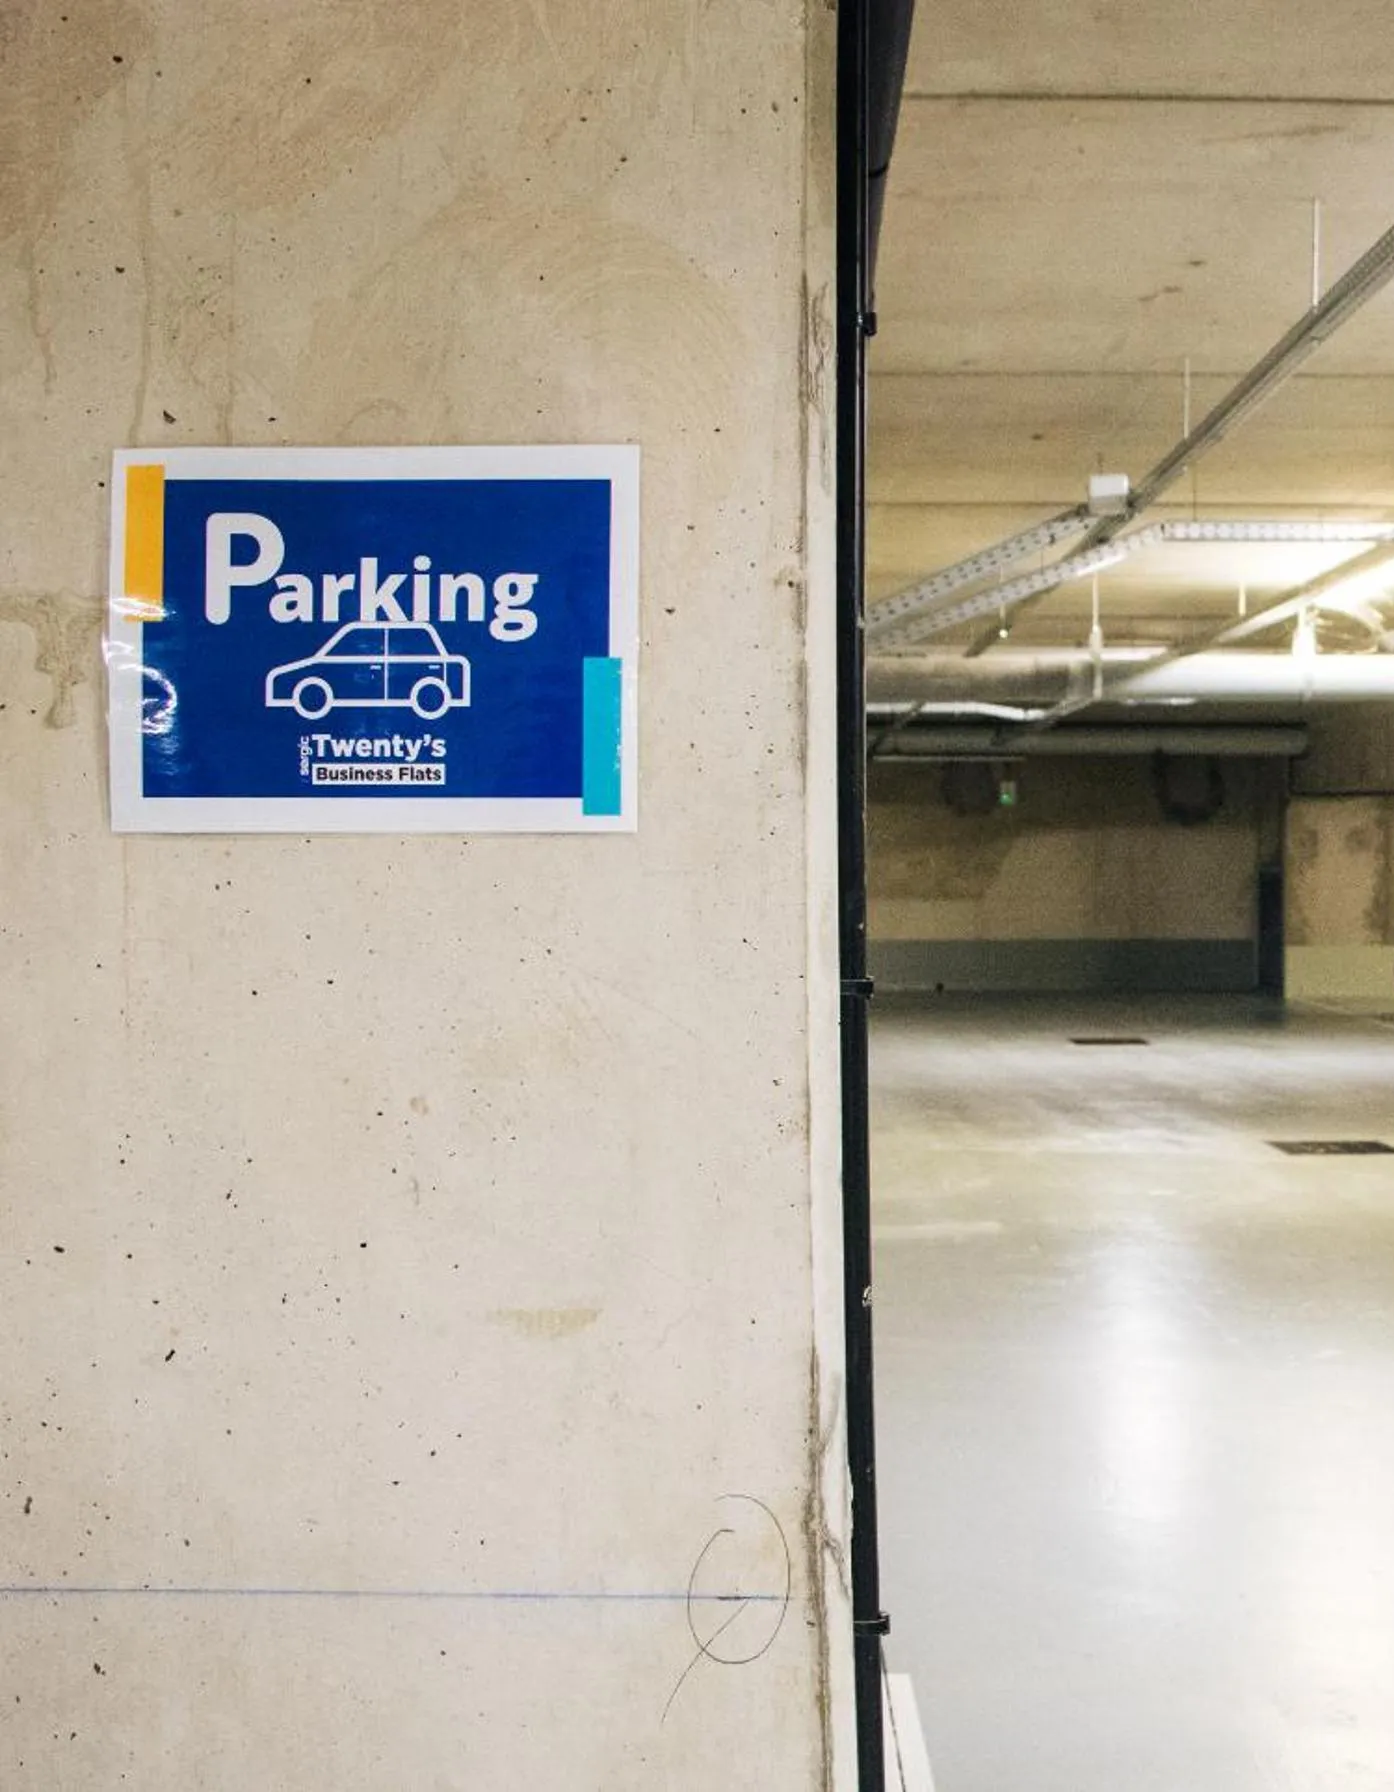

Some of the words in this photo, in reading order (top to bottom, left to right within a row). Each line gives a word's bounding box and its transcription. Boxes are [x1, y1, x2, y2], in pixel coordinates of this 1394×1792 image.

[205, 512, 539, 642] Parking
[316, 766, 393, 781] Business
[398, 766, 442, 781] Flats
